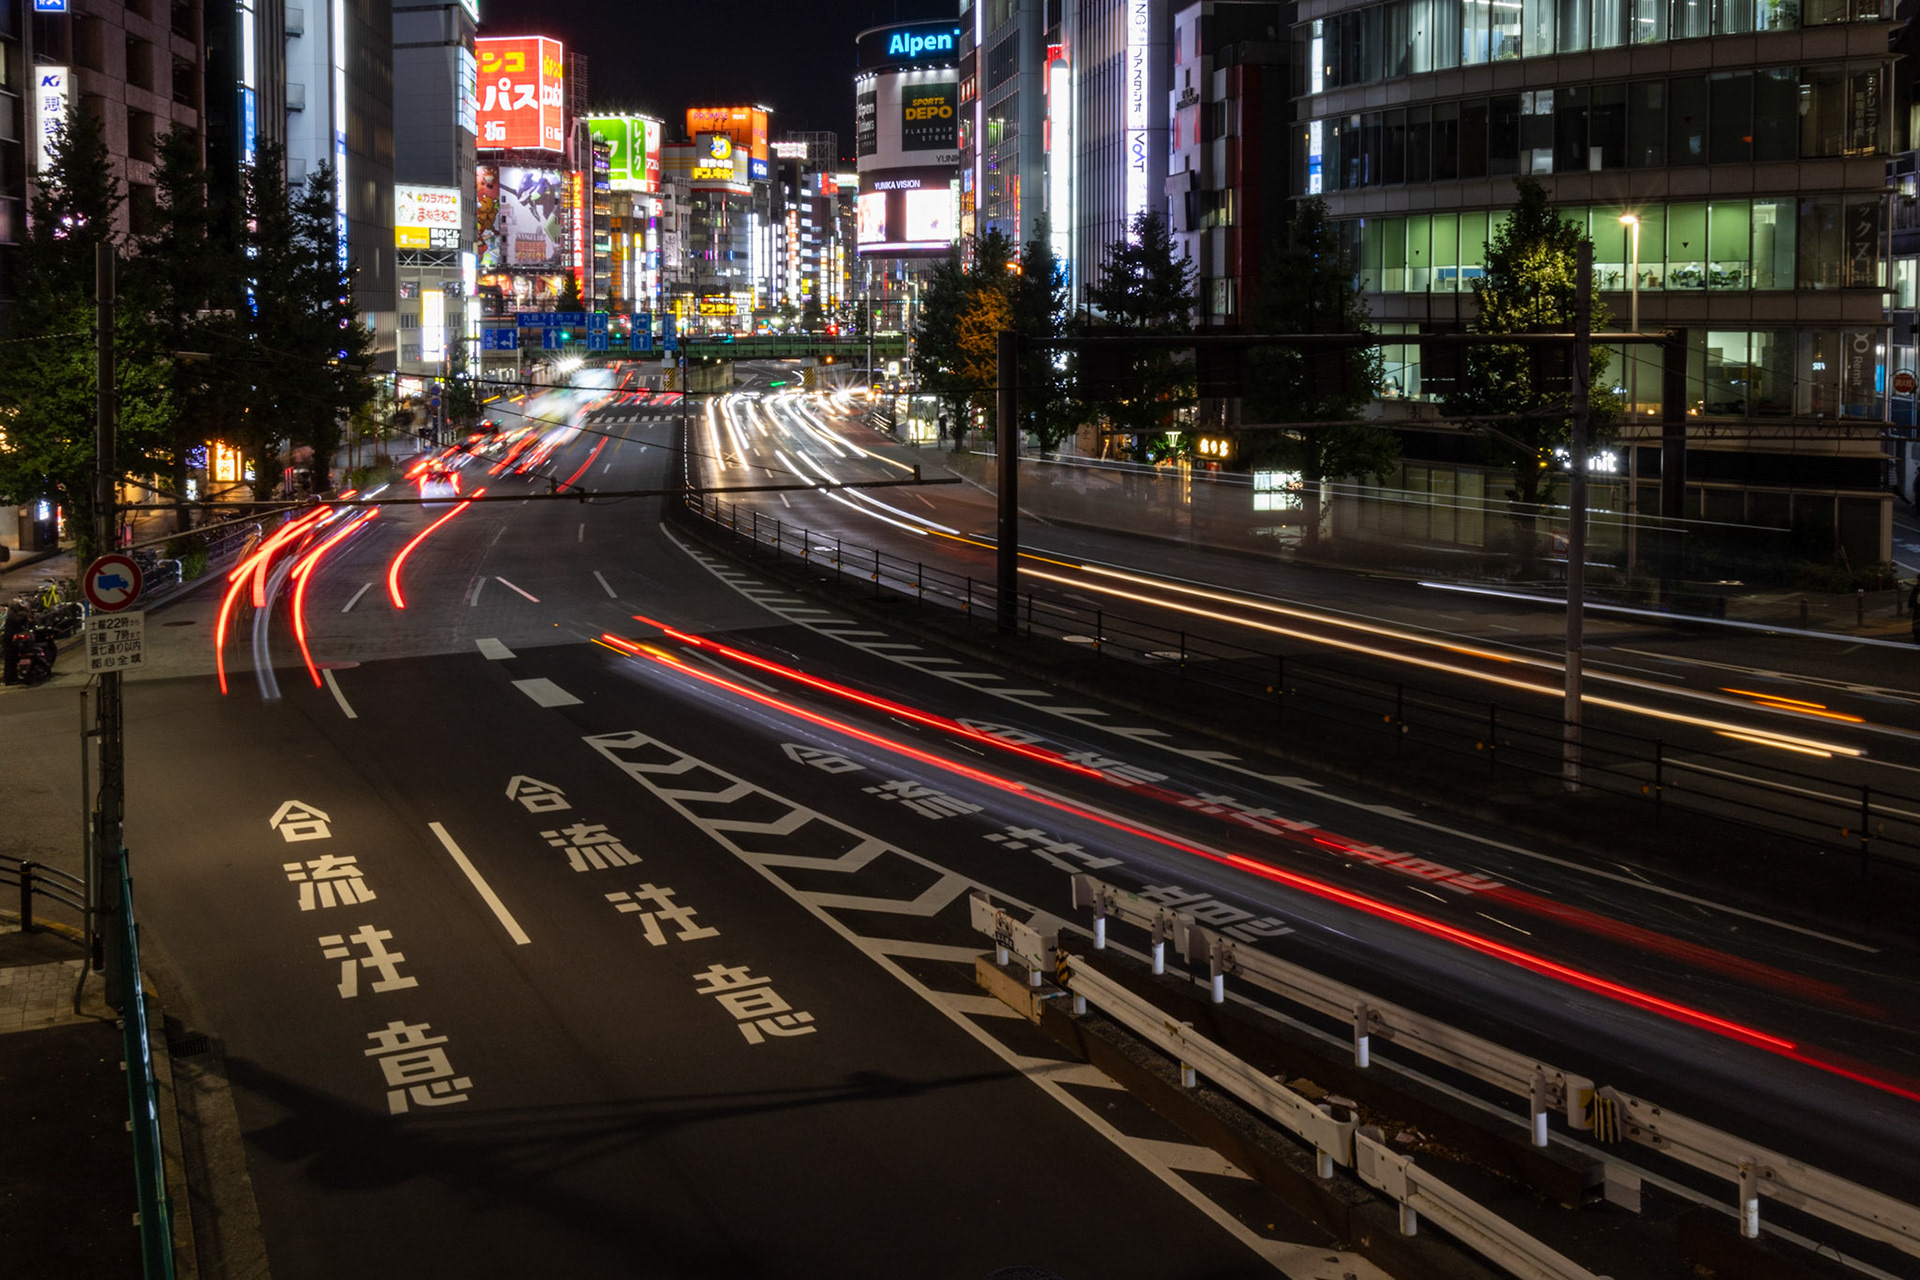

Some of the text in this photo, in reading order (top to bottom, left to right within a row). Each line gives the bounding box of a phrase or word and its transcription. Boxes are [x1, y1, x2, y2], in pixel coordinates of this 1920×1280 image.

[889, 33, 952, 57] Alpen
[475, 50, 525, 73] ンコ
[475, 77, 538, 111] パス
[912, 97, 944, 107] SPORTS
[694, 111, 728, 120] PROMISE
[905, 105, 953, 120] DEPO
[905, 126, 953, 135] FLAGSHIP
[874, 180, 920, 190] YUNIKA VISION
[423, 193, 451, 205] カラオケ
[417, 207, 457, 223] まねきねこ
[523, 314, 548, 322] 九段下
[1853, 356, 1863, 386] Remit
[505, 775, 818, 1045] 合流注意
[269, 799, 474, 1115] 合流注意
